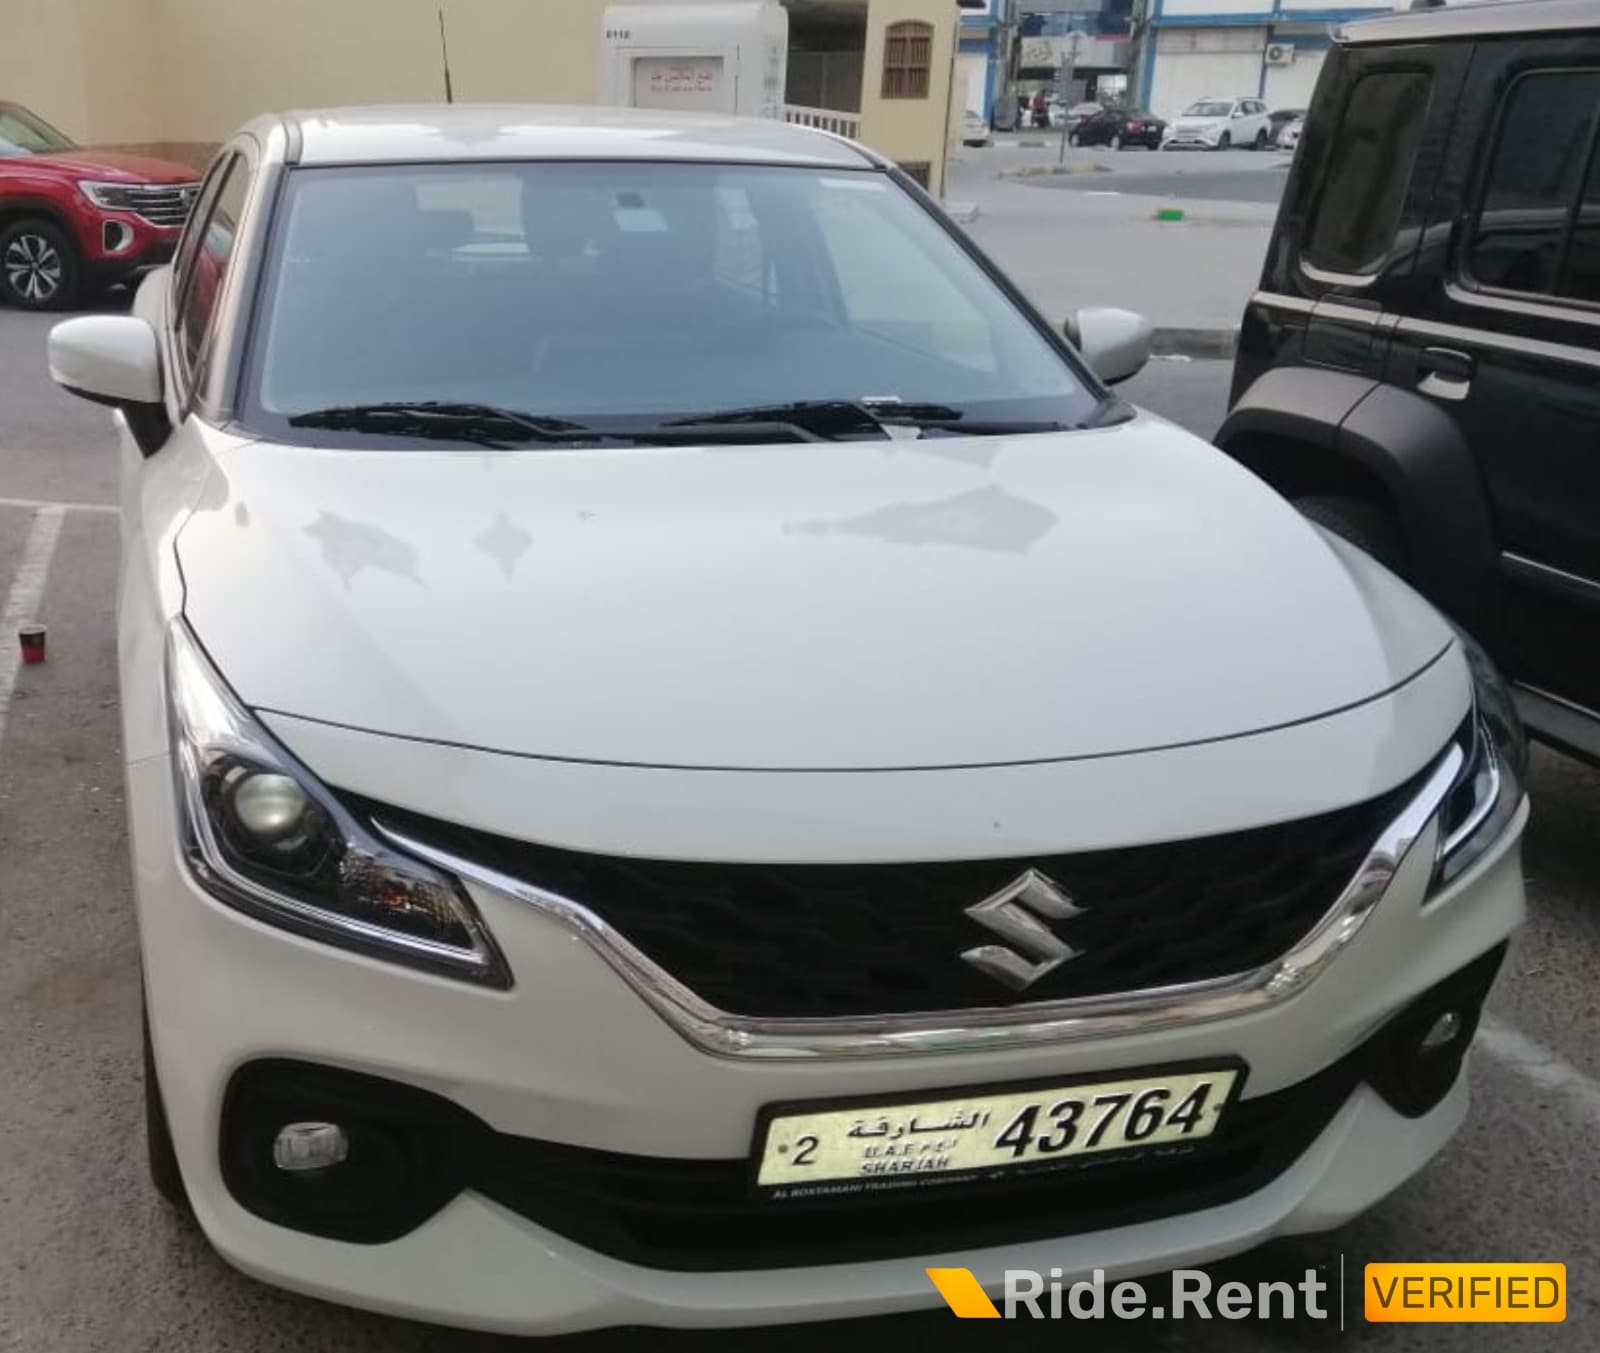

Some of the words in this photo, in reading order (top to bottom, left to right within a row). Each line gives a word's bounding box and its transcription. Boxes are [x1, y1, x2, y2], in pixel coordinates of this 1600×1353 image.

[847, 1109, 991, 1140] الشارقة
[995, 1083, 1213, 1158] 43764
[792, 1135, 820, 1166] 2
[860, 1157, 949, 1176] SHARJAH
